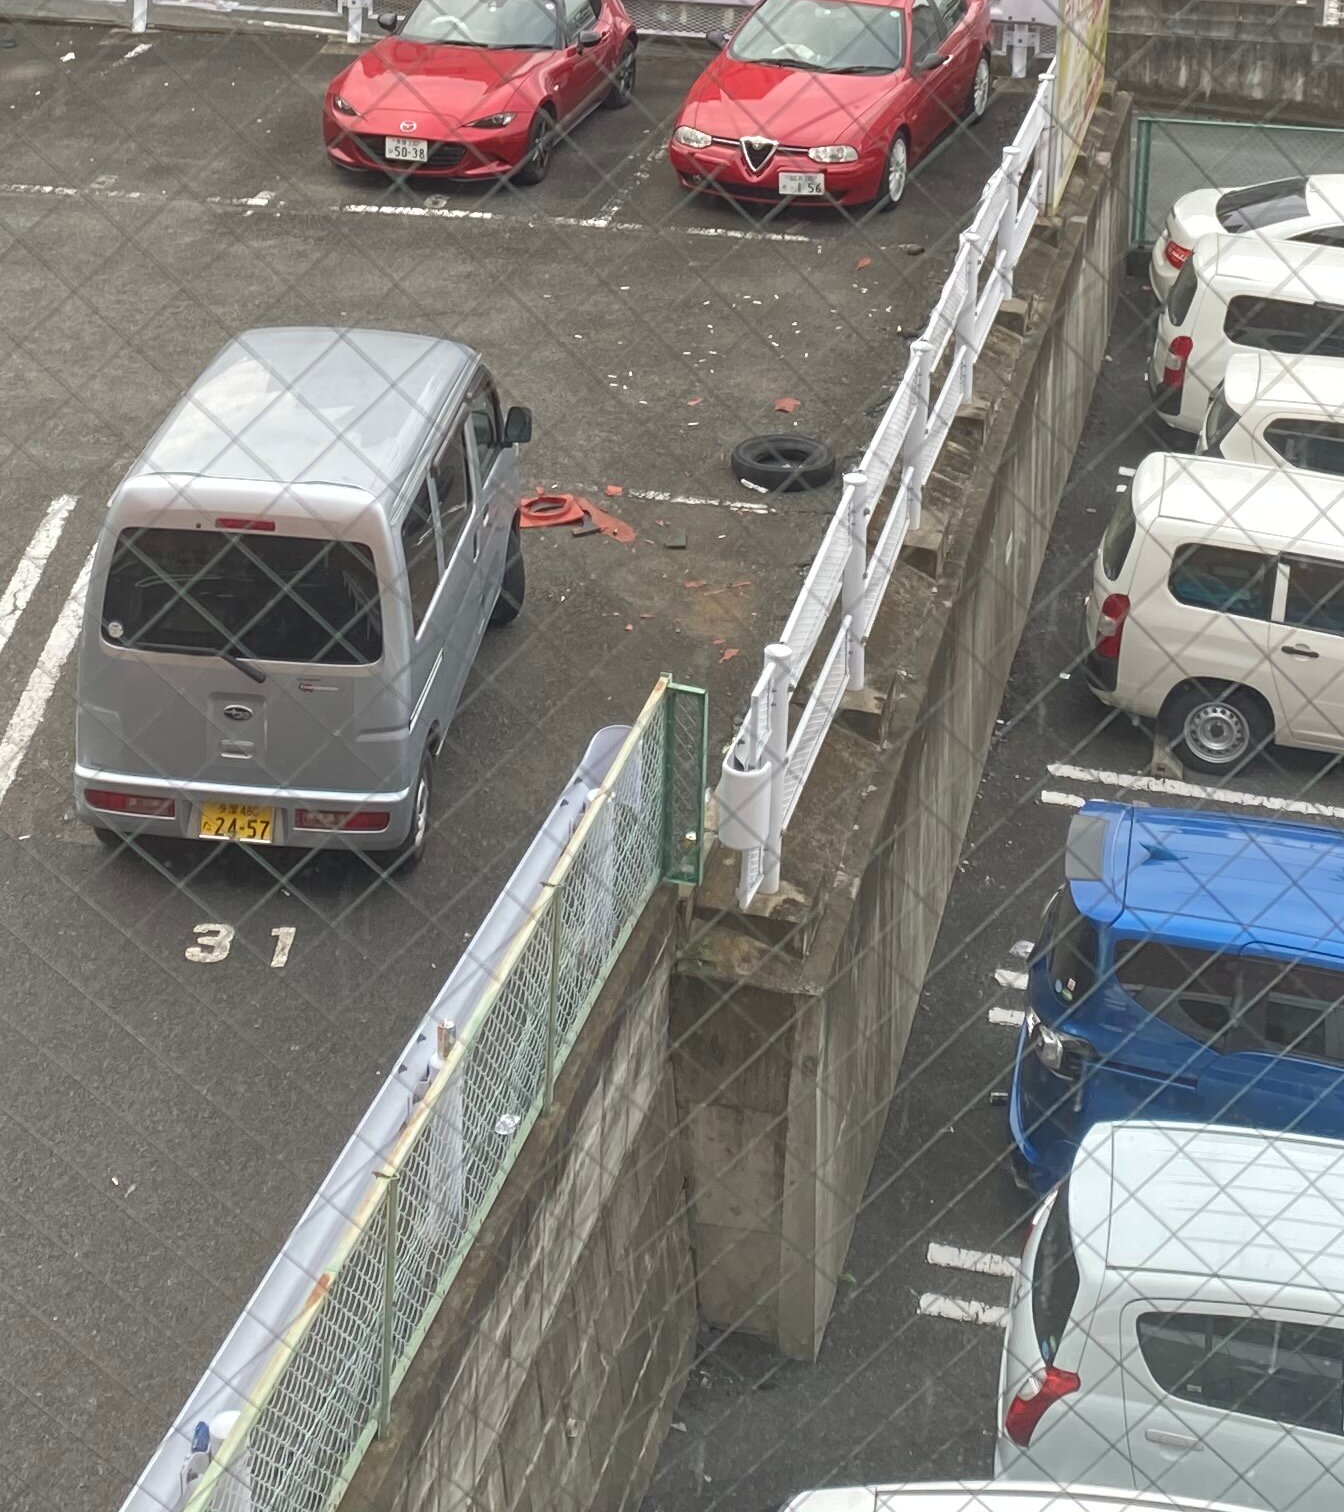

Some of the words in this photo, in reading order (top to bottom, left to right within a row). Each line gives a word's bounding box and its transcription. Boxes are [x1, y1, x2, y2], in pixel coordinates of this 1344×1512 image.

[394, 145, 425, 160] 50-38
[214, 816, 271, 840] 24-57
[183, 922, 298, 968] 31
